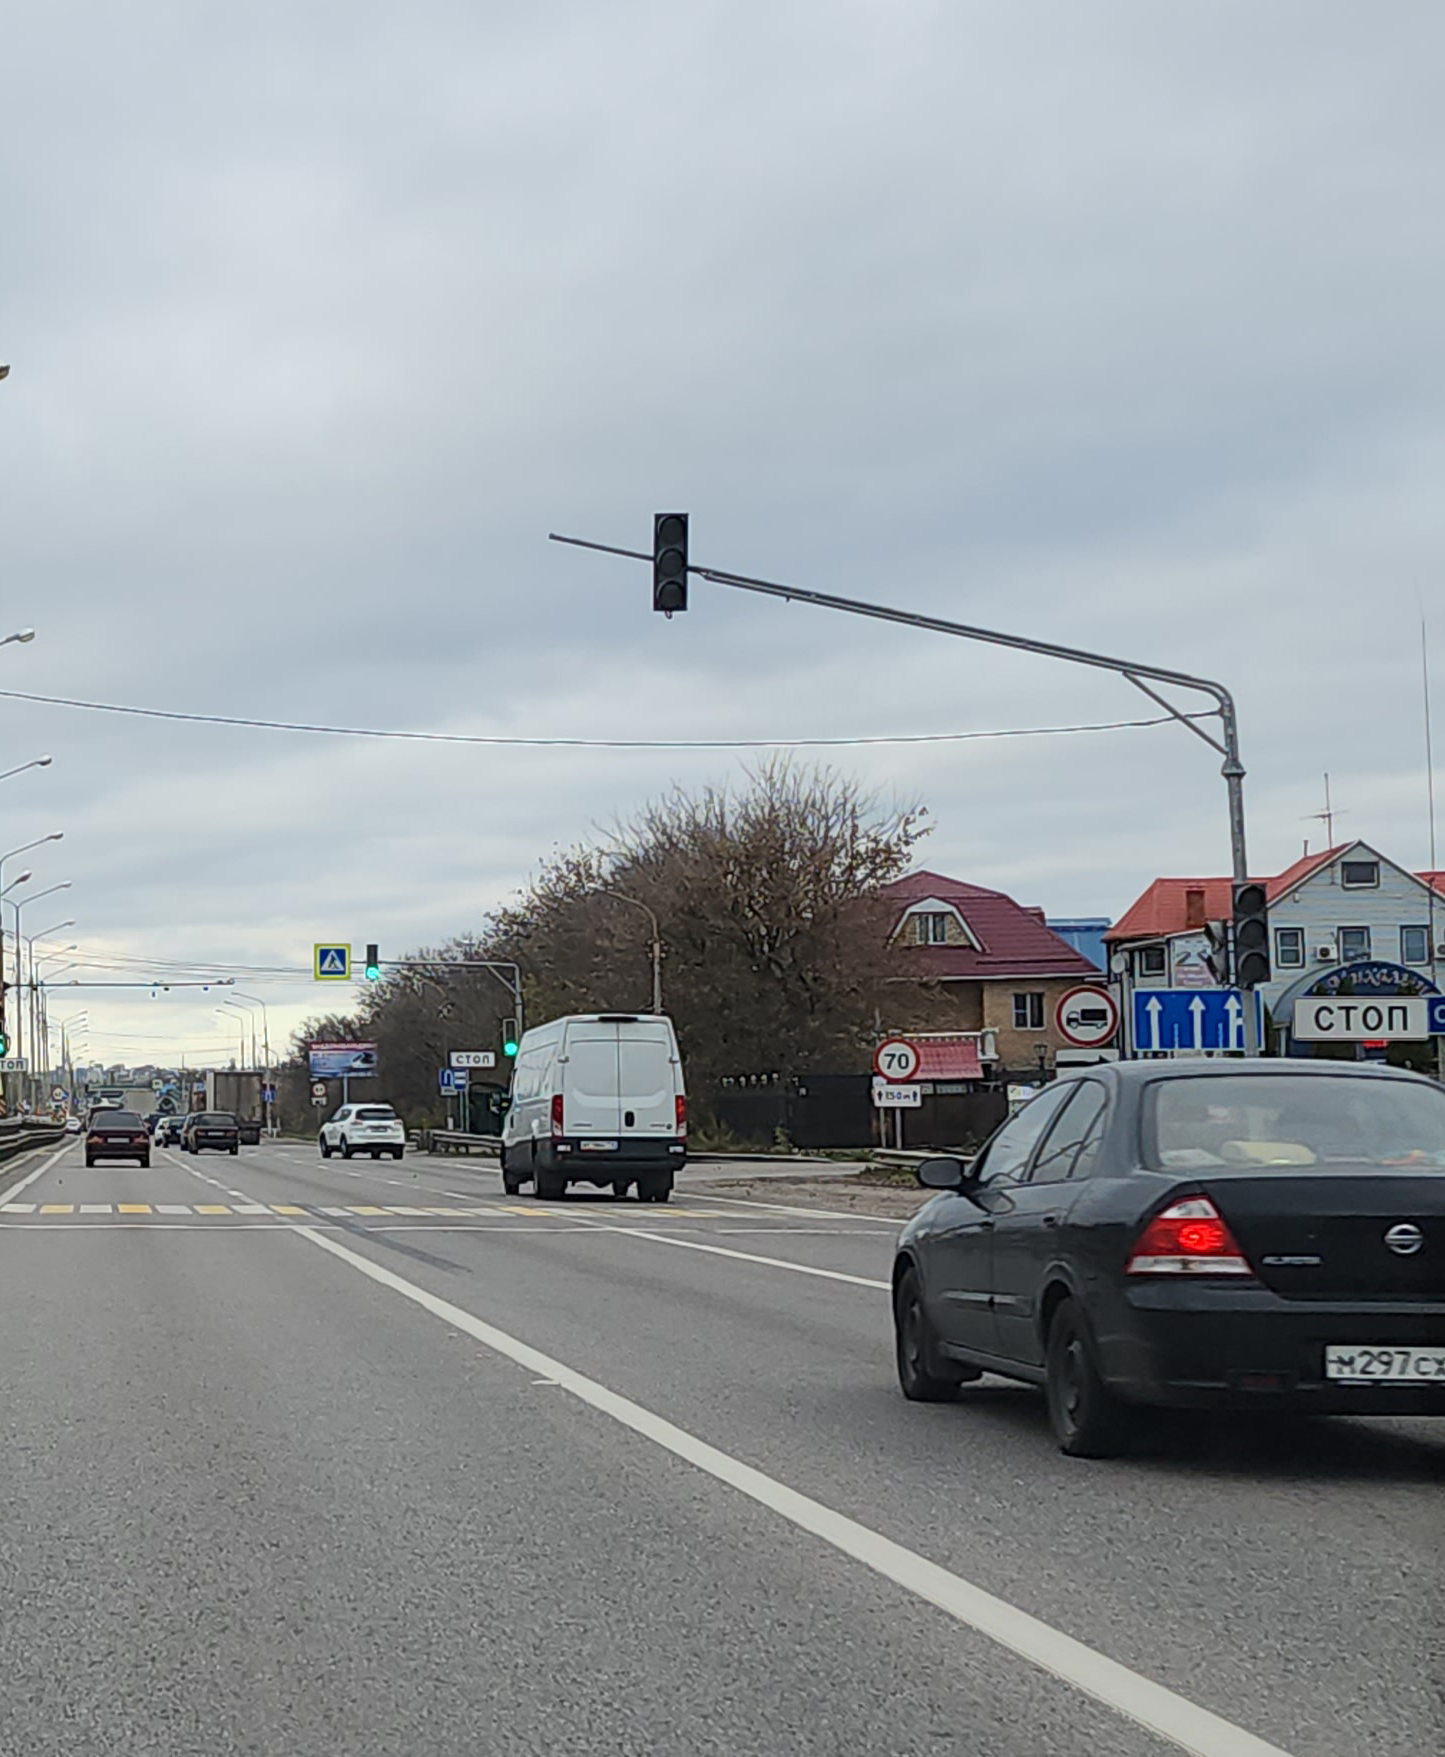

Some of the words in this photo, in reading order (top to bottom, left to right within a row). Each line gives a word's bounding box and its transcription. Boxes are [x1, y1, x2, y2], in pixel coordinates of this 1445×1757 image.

[1314, 1005, 1408, 1031] СТОП
[457, 1055, 490, 1064] СТОП
[884, 1053, 909, 1070] 70
